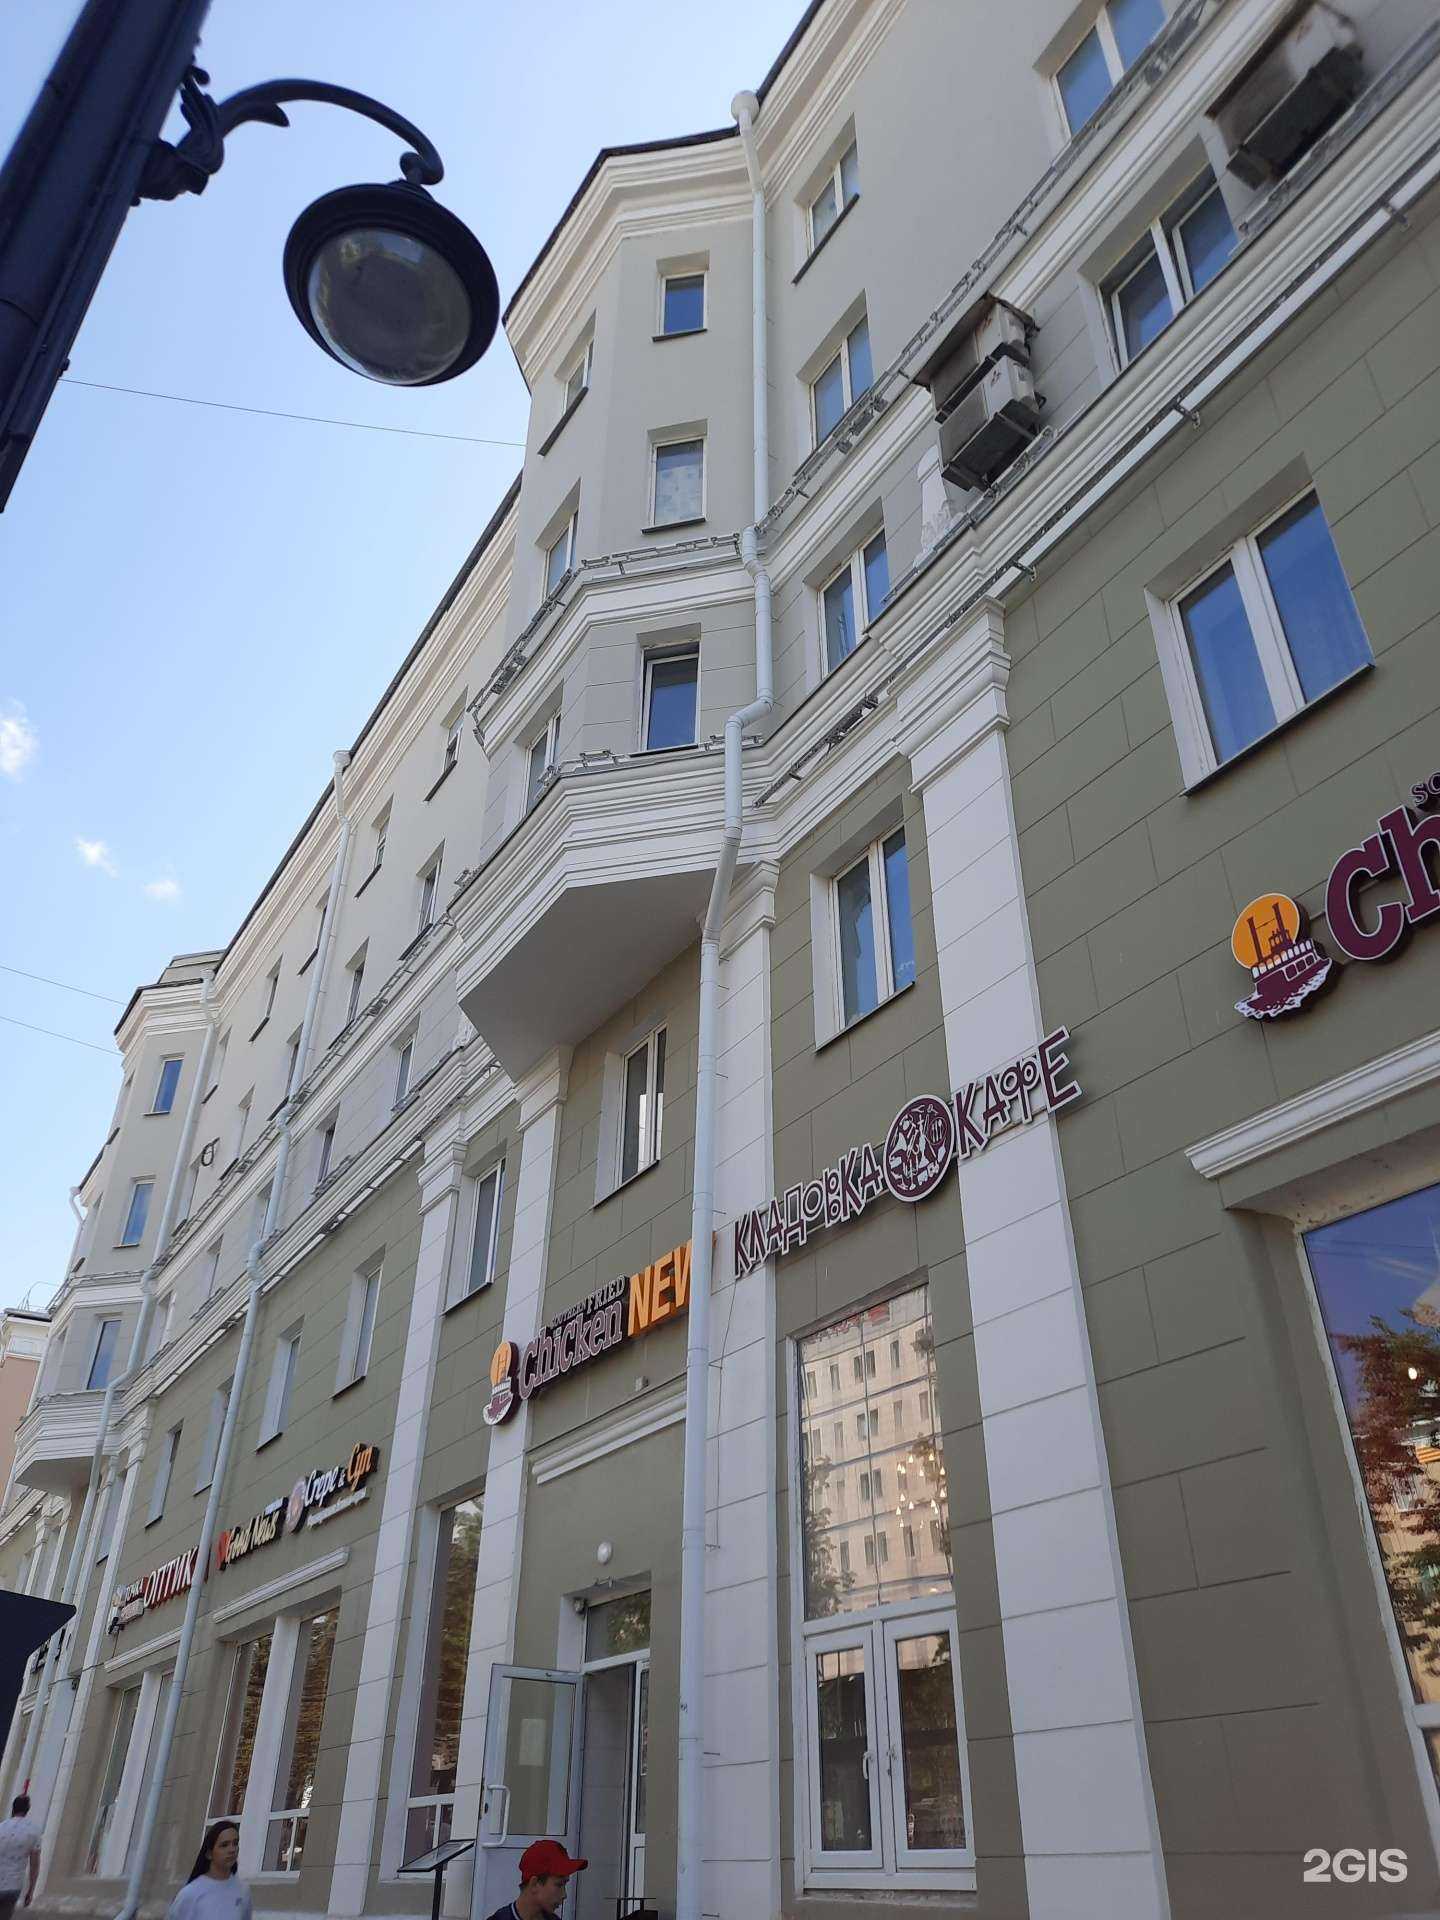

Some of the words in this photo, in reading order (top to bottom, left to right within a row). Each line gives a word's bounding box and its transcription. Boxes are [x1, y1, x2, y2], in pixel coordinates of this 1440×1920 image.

[734, 1143, 884, 1279] КЛАДОВКА
[953, 1024, 1083, 1160] КАФЕ
[585, 1274, 626, 1315] FRIED
[518, 1299, 623, 1400] Chicken
[143, 1545, 199, 1608] ОПТИК
